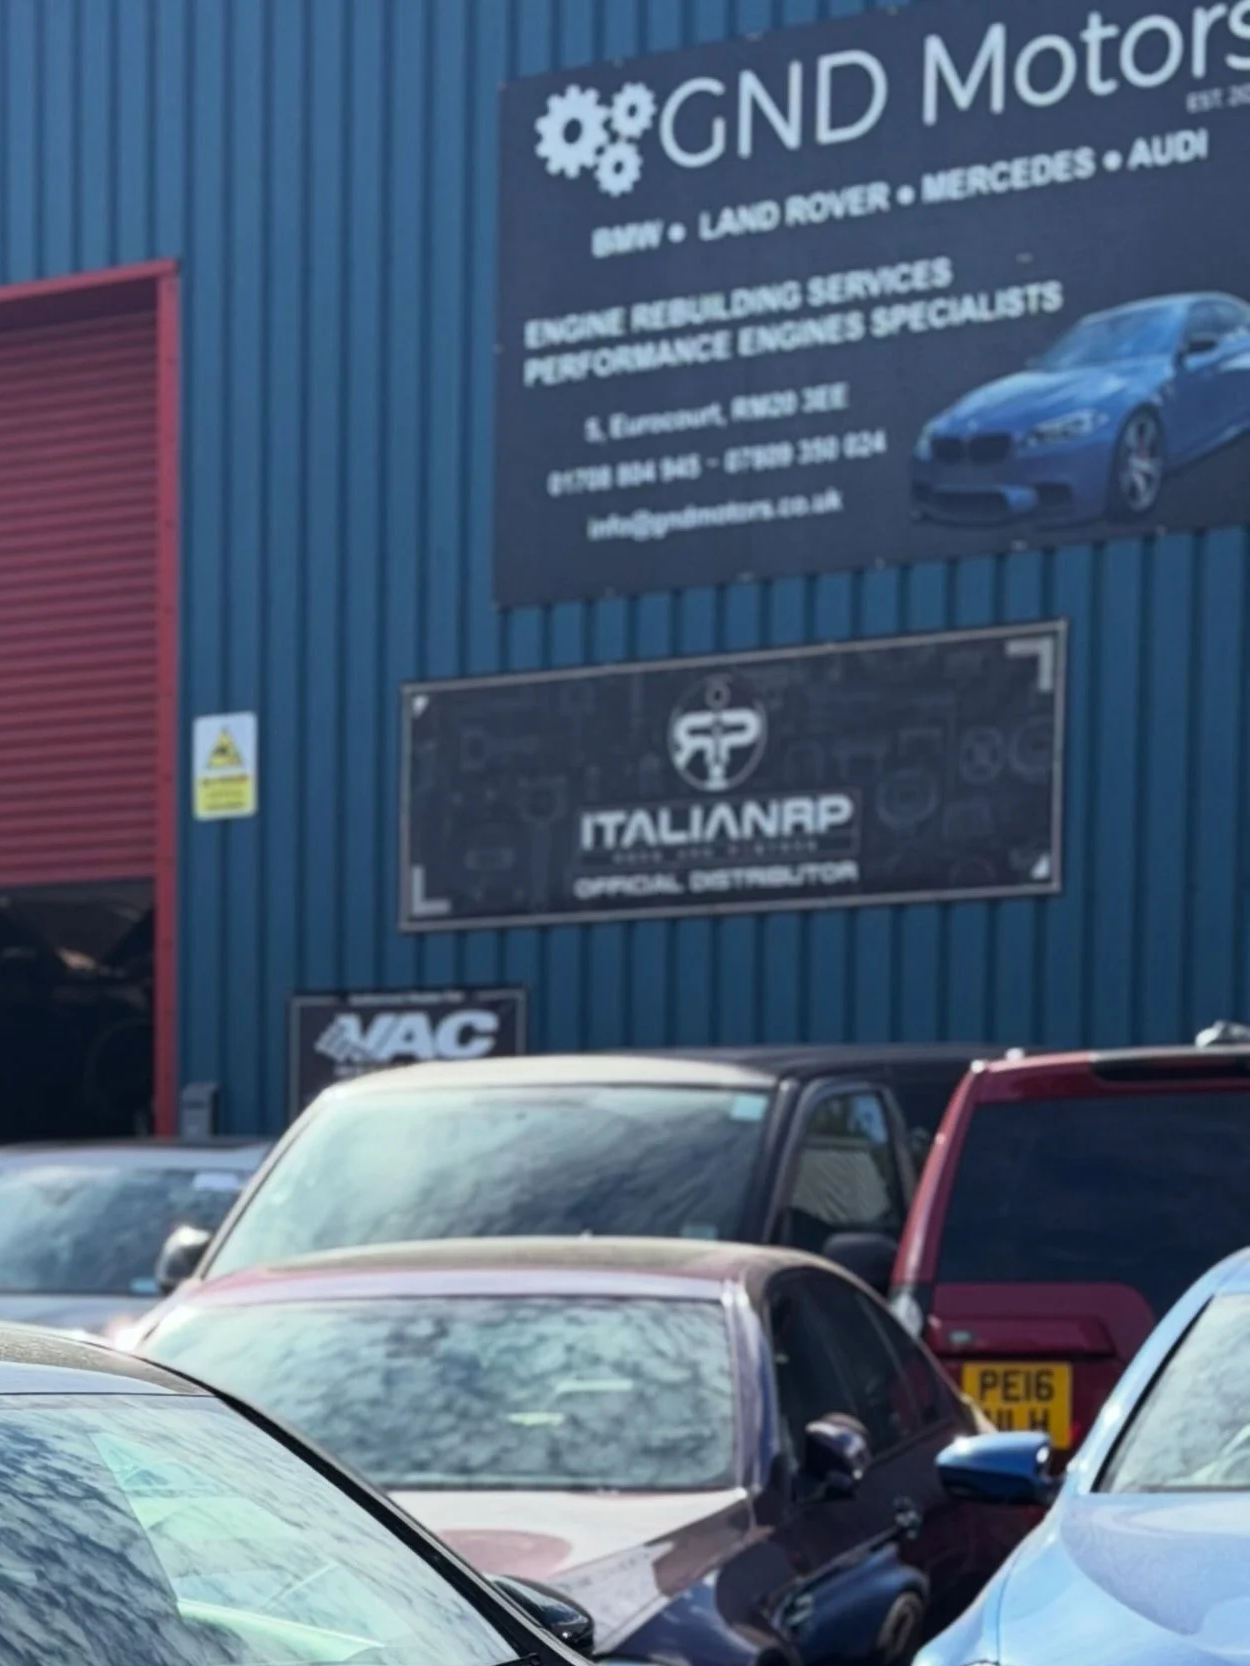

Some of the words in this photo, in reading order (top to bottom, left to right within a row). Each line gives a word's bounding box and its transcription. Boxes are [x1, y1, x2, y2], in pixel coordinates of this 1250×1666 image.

[659, 49, 888, 168] GND
[591, 219, 664, 258] BMW
[699, 200, 780, 241] LAND
[784, 181, 890, 227] ROVER
[921, 146, 1097, 204] MERCEDES
[1127, 127, 1210, 171] AUDI
[523, 329, 733, 388] PERFORMANCE
[737, 310, 866, 358] ENGINES
[870, 279, 1064, 338] SPECIALISTS
[524, 306, 626, 350] ENGINE
[630, 279, 802, 333] REBUILDING
[807, 256, 954, 308] SERVICES
[580, 793, 855, 851] ITALIANRP
[573, 873, 685, 900] OFFICIAL
[688, 858, 859, 893] DISTRIBUTOR
[981, 1369, 1055, 1403] PE16
